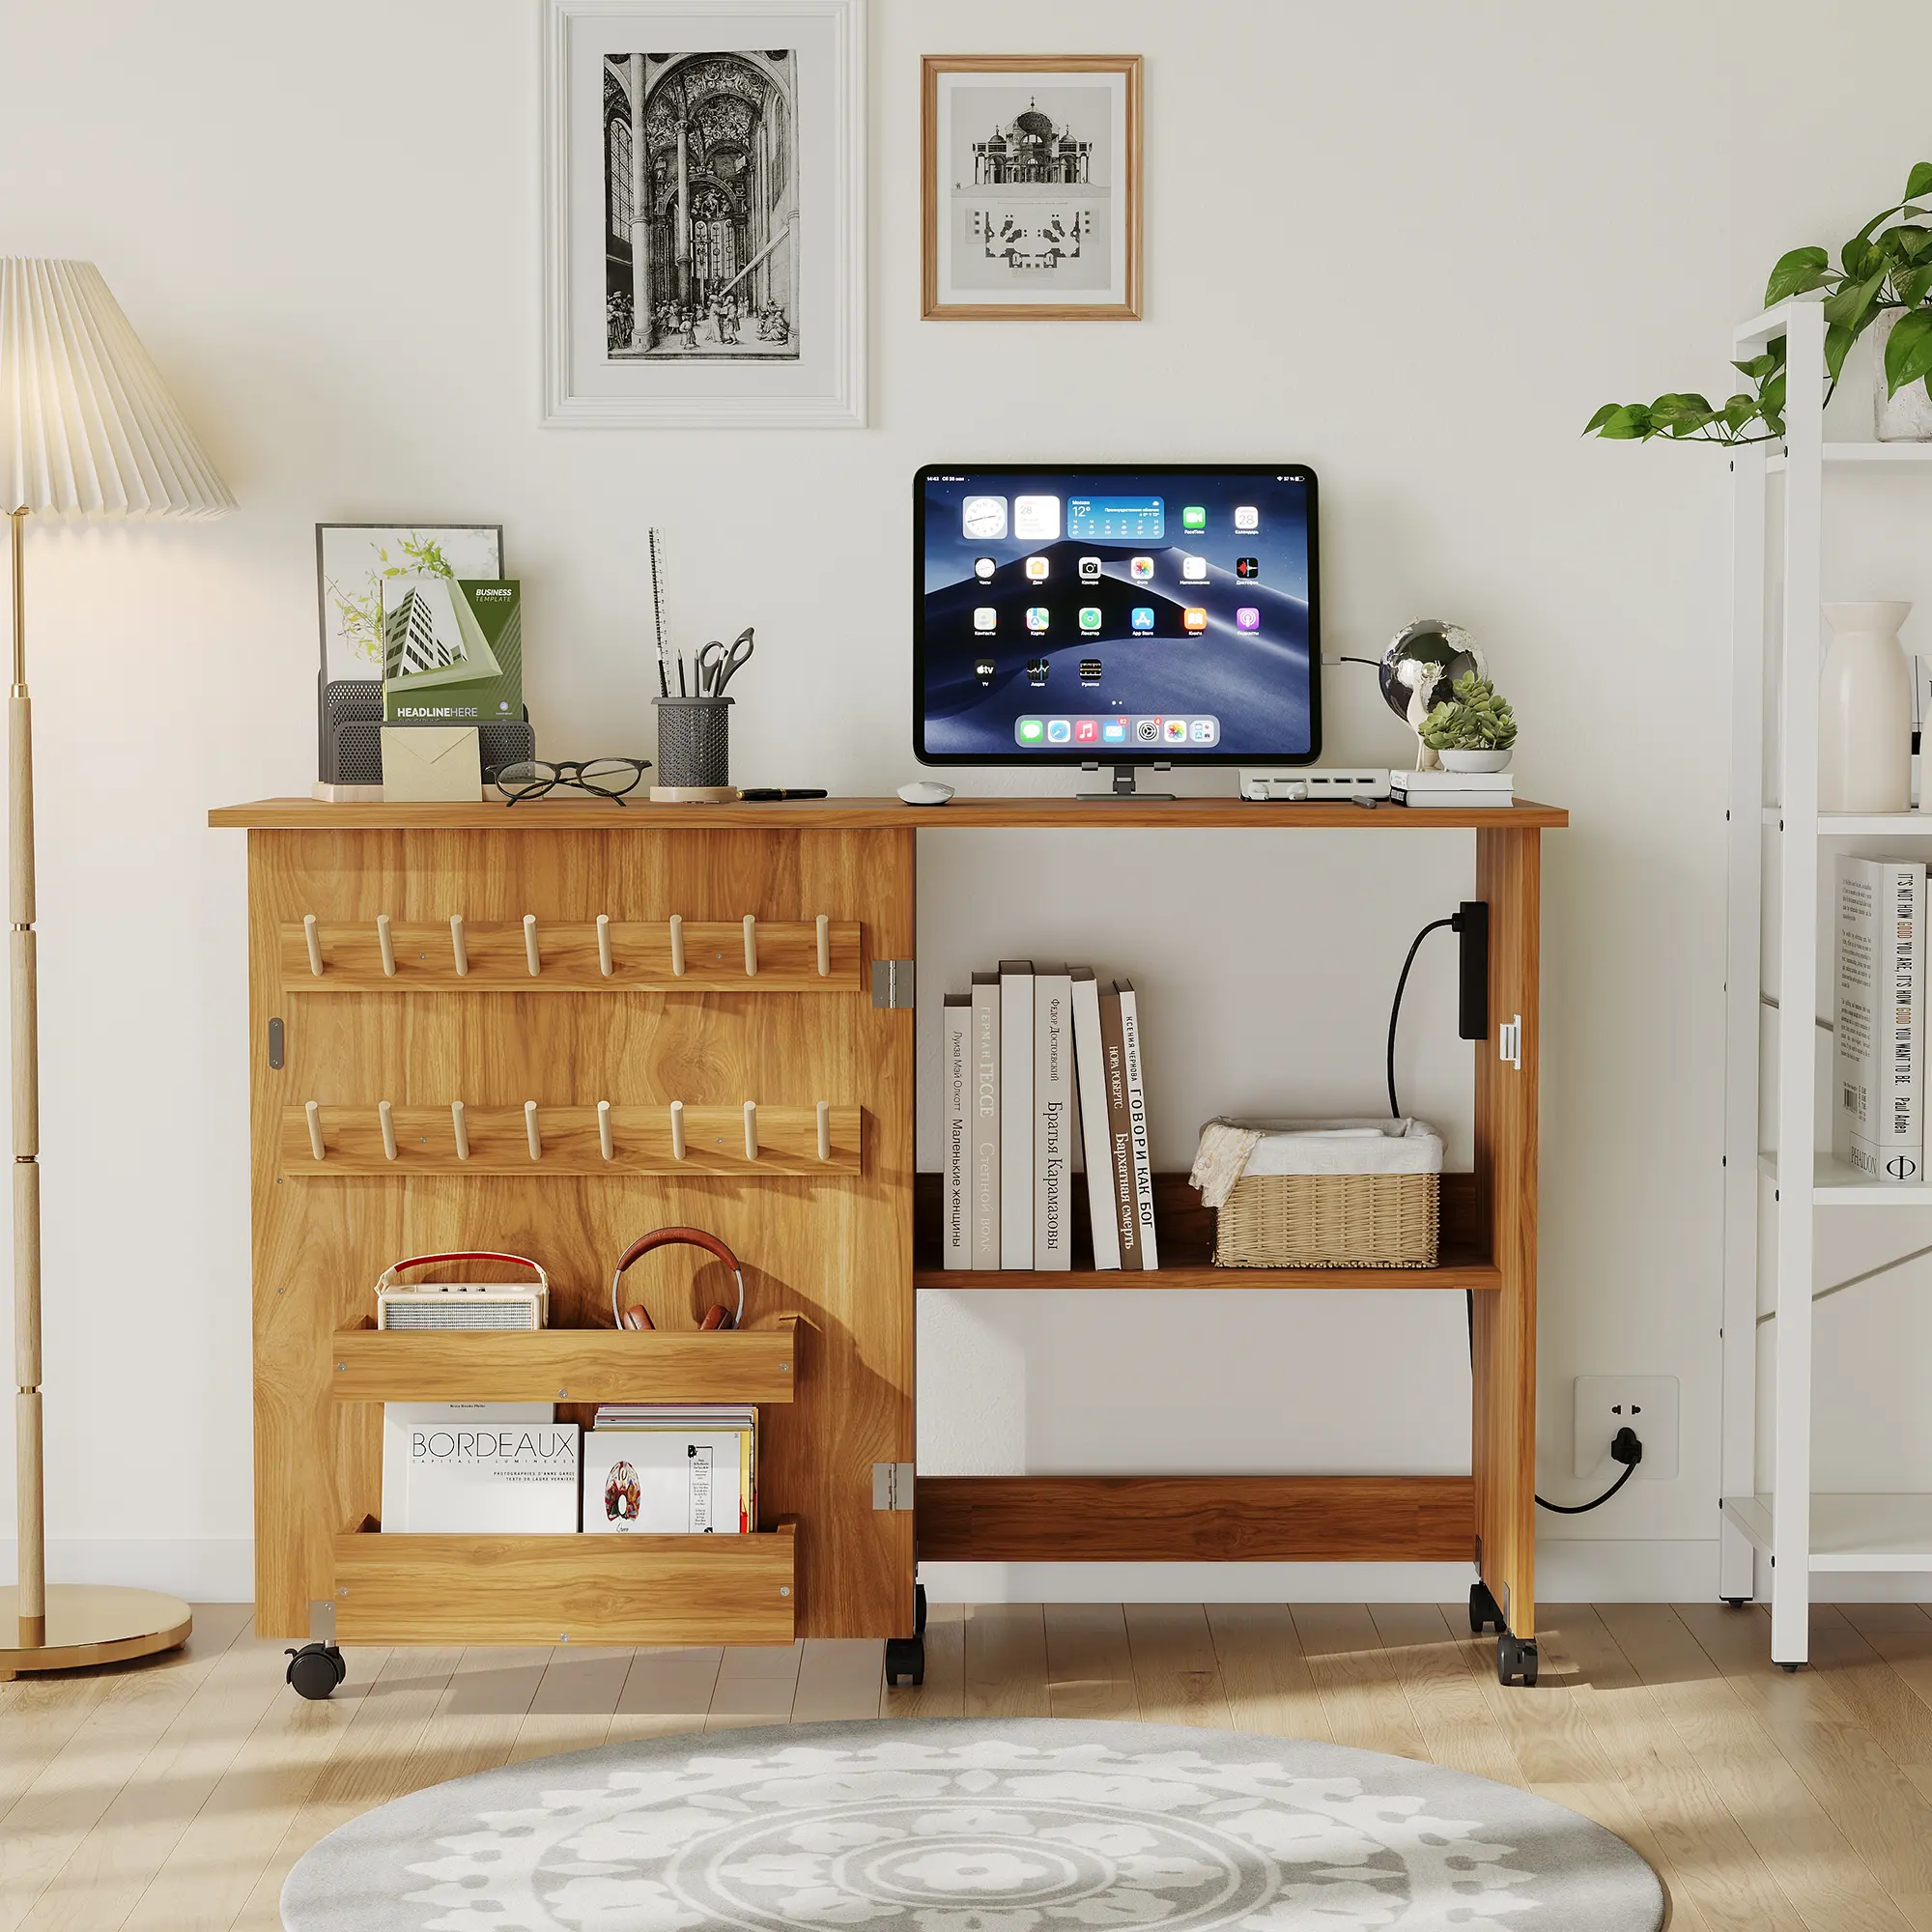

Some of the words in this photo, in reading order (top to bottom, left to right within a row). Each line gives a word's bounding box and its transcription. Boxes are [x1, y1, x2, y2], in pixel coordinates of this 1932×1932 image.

[1238, 514, 1255, 526] 28
[1897, 873, 1913, 886] IT'S
[1897, 889, 1913, 901] NOT
[1896, 904, 1913, 919] HOW
[1896, 921, 1912, 938] GOOD
[1896, 941, 1912, 954] YOU
[1894, 957, 1912, 972] ARE,
[1895, 975, 1912, 987] IT'S
[1895, 989, 1912, 1005] HOW
[1895, 1007, 1911, 1024] GOOD
[1125, 1015, 1135, 1048] КСЕНИЯ
[1895, 1027, 1911, 1039] YOU
[952, 1031, 962, 1057] Луиза
[1894, 1042, 1911, 1062] WANT
[1109, 1045, 1120, 1069] НОРА
[1128, 1050, 1138, 1081] ЧЕРНОВА
[1894, 1064, 1911, 1072] TO
[953, 1059, 962, 1079] Мэй
[980, 1062, 994, 1117] ГЕССЕ
[1111, 1070, 1122, 1109] РОБЕРТС
[1894, 1075, 1910, 1086] BE.
[952, 1080, 963, 1111] Олкотт
[1894, 1097, 1910, 1111] Paul
[1042, 1101, 1063, 1153] Братья
[1130, 1089, 1148, 1160] ГОВОРИ
[1894, 1114, 1910, 1133] Arden
[952, 1119, 962, 1185] Маленькие
[1114, 1132, 1130, 1203] Бархатная
[1137, 1167, 1151, 1195] КАК
[1042, 1158, 1063, 1249] Карамазовы
[951, 1188, 961, 1247] женщины
[1140, 1202, 1153, 1228] БОГ
[1120, 1205, 1134, 1249] смерть
[412, 1432, 574, 1458] BORDEAUX
